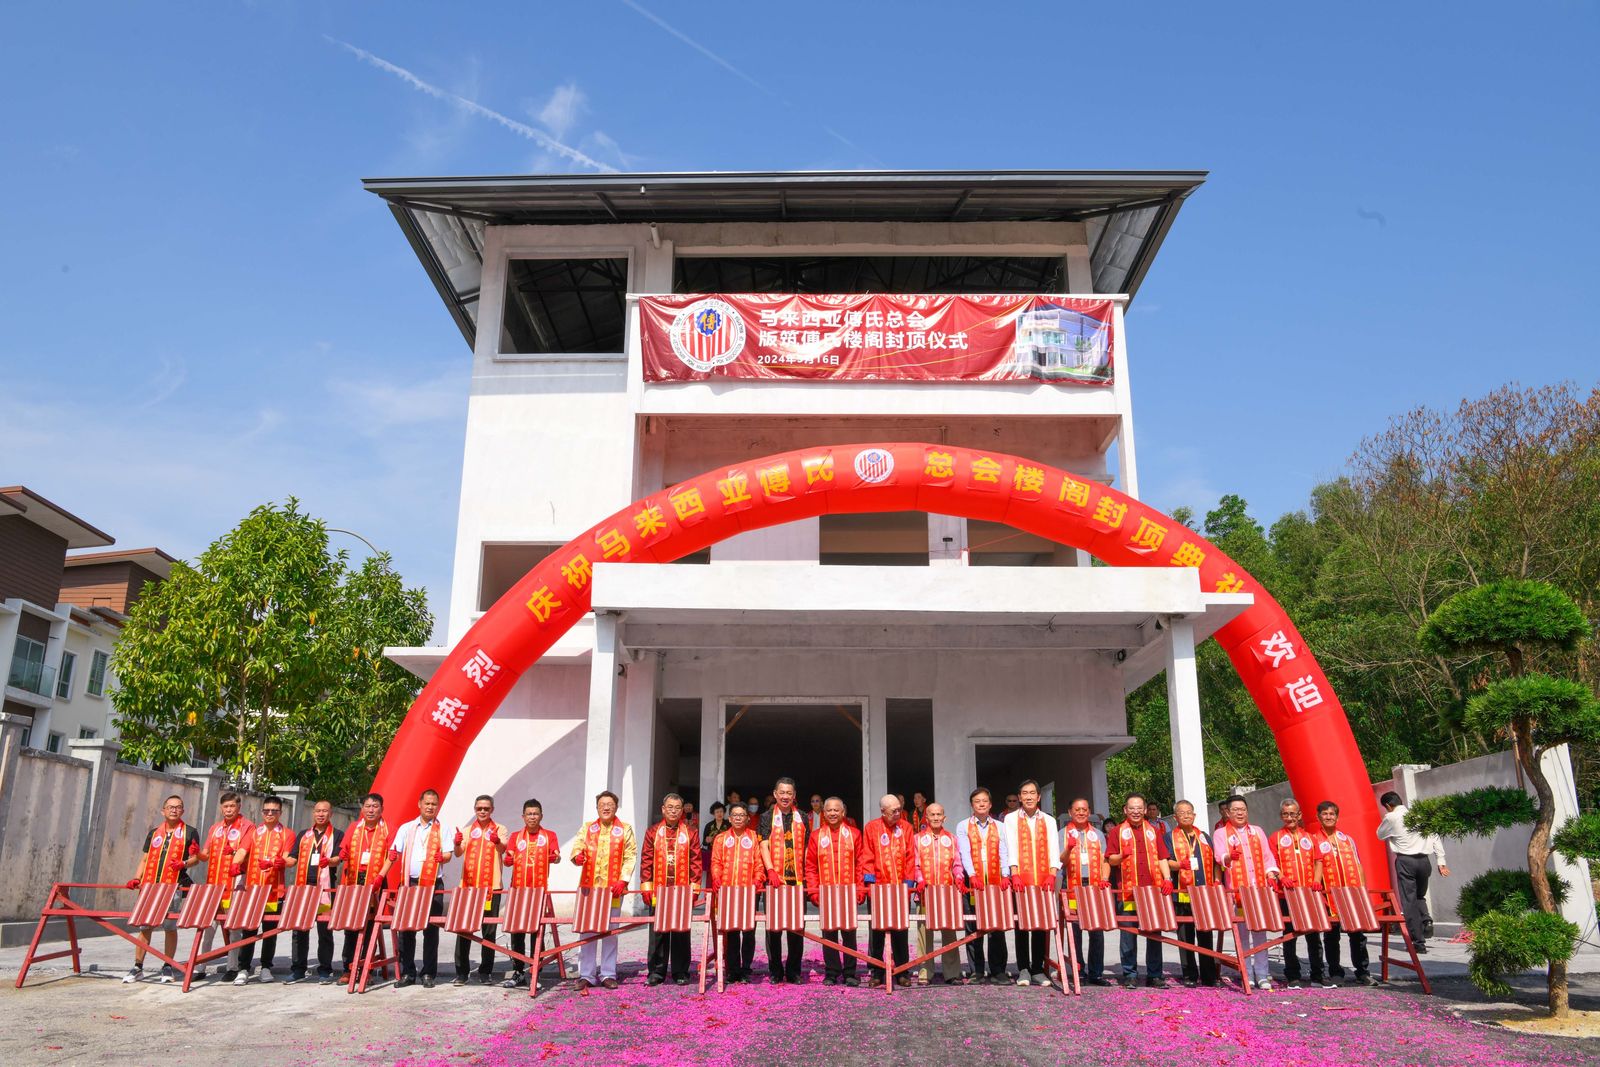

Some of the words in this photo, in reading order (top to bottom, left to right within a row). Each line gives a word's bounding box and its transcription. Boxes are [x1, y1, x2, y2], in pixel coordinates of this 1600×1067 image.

[759, 310, 926, 328] 马来西亚傅氏总会
[432, 649, 501, 731] 热烈
[1260, 630, 1324, 713] 欢迎
